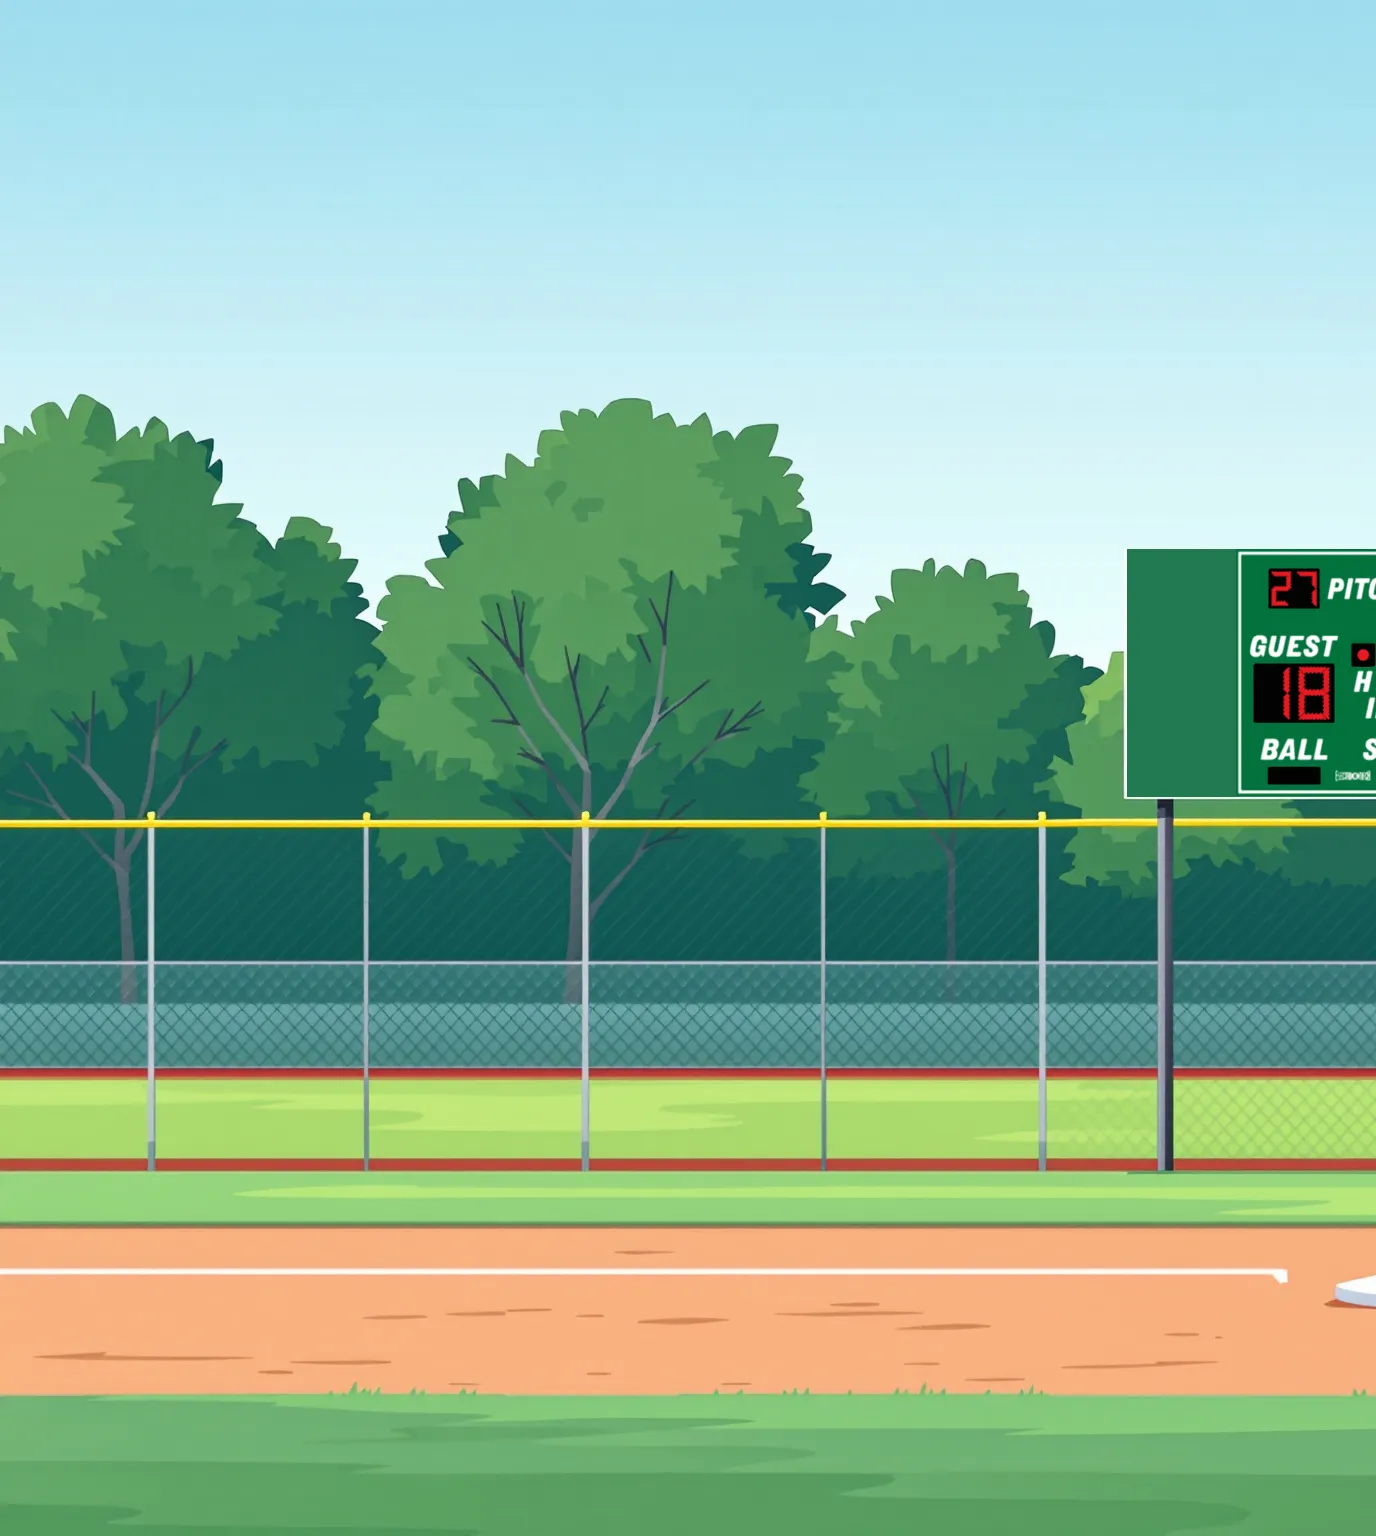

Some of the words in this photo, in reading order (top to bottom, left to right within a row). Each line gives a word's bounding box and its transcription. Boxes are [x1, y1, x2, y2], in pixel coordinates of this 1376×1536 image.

[1272, 572, 1317, 606] 27
[1250, 635, 1338, 657] GUEST
[1354, 671, 1372, 692] H
[1283, 667, 1330, 720] 18
[1261, 739, 1327, 760] BALL
